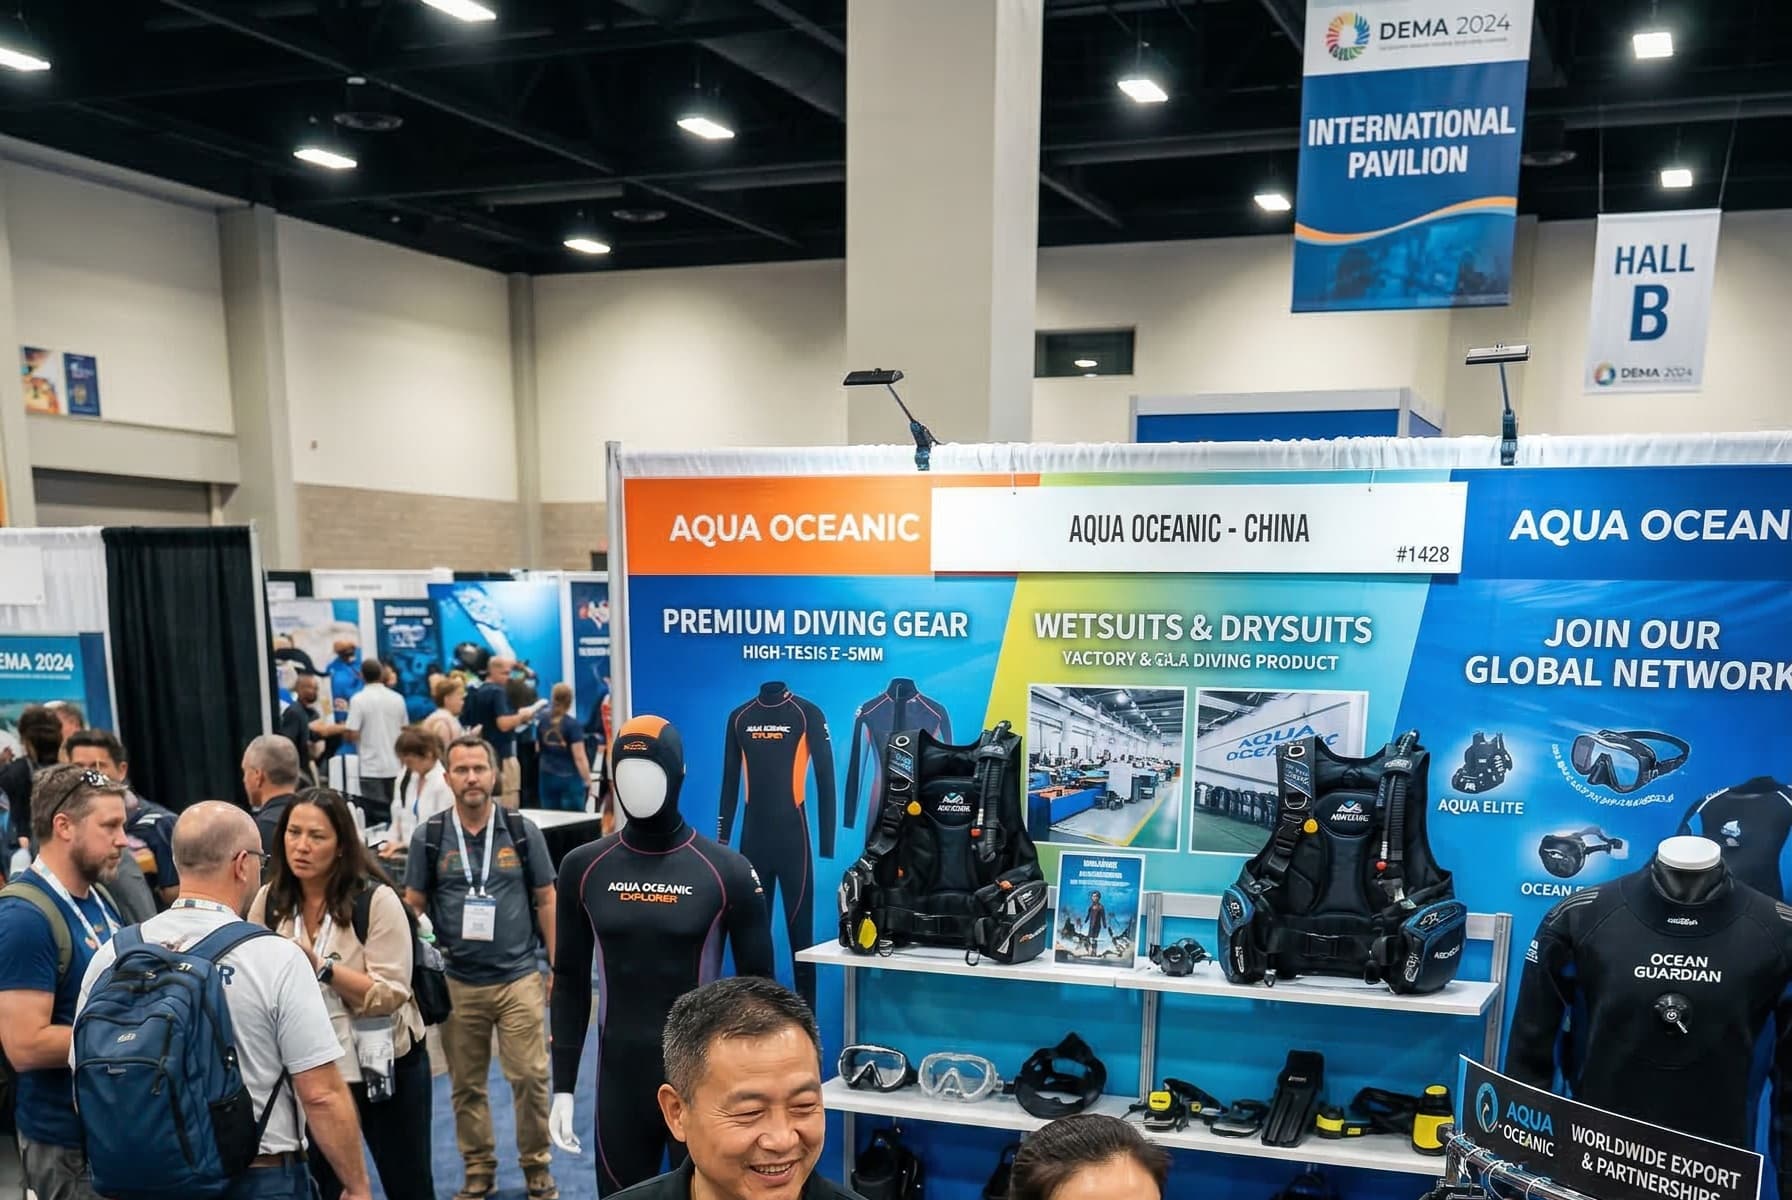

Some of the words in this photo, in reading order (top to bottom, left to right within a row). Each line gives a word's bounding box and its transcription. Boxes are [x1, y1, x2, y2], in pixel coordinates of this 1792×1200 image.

[1379, 18, 1449, 40] DEMA
[1456, 13, 1512, 35] 2024
[1308, 106, 1516, 146] INTERNATIONAL
[1348, 145, 1468, 178] PAVILION
[1614, 243, 1695, 275] HALL
[1629, 284, 1669, 341] B
[1621, 367, 1660, 378] DEMA
[669, 514, 762, 548] AQUA
[769, 512, 921, 543] OCEANIC
[1069, 513, 1125, 544] AQUA
[1131, 513, 1221, 543] OCEANIC
[1244, 512, 1310, 543] CHINA
[1509, 508, 1628, 548] AQUA
[1640, 508, 1792, 541] OCEAN
[1396, 545, 1450, 564] #1428
[663, 608, 786, 635] PREMIUM
[792, 610, 886, 636] DIVING
[893, 610, 968, 638] GEAR
[1034, 612, 1184, 641] WETSUITS
[1190, 614, 1213, 641] &
[1220, 615, 1373, 645] DRYSUITS
[1543, 618, 1633, 649] JOIN
[1639, 620, 1721, 650] OUR
[35, 652, 75, 672] 2024
[1140, 652, 1152, 666] &
[1194, 654, 1251, 669] DIVING
[1255, 655, 1339, 671] PRODUCT
[1464, 655, 1603, 687] GLOBAL
[1613, 658, 1792, 691] NETWORK
[1238, 724, 1315, 749] AQUA
[1438, 799, 1479, 816] AQUA
[1483, 800, 1525, 815] ELITE
[608, 881, 641, 892] AQUA
[1521, 882, 1572, 897] OCEAN
[1634, 965, 1722, 983] GUARDIAN
[1650, 953, 1708, 968] OCEAN
[1506, 1101, 1554, 1136] AQUA
[1503, 1124, 1554, 1157] OCEANIC
[1571, 1123, 1667, 1169] WORLDWIDE
[1671, 1155, 1742, 1190] EXPORT
[1581, 1152, 1594, 1171] &
